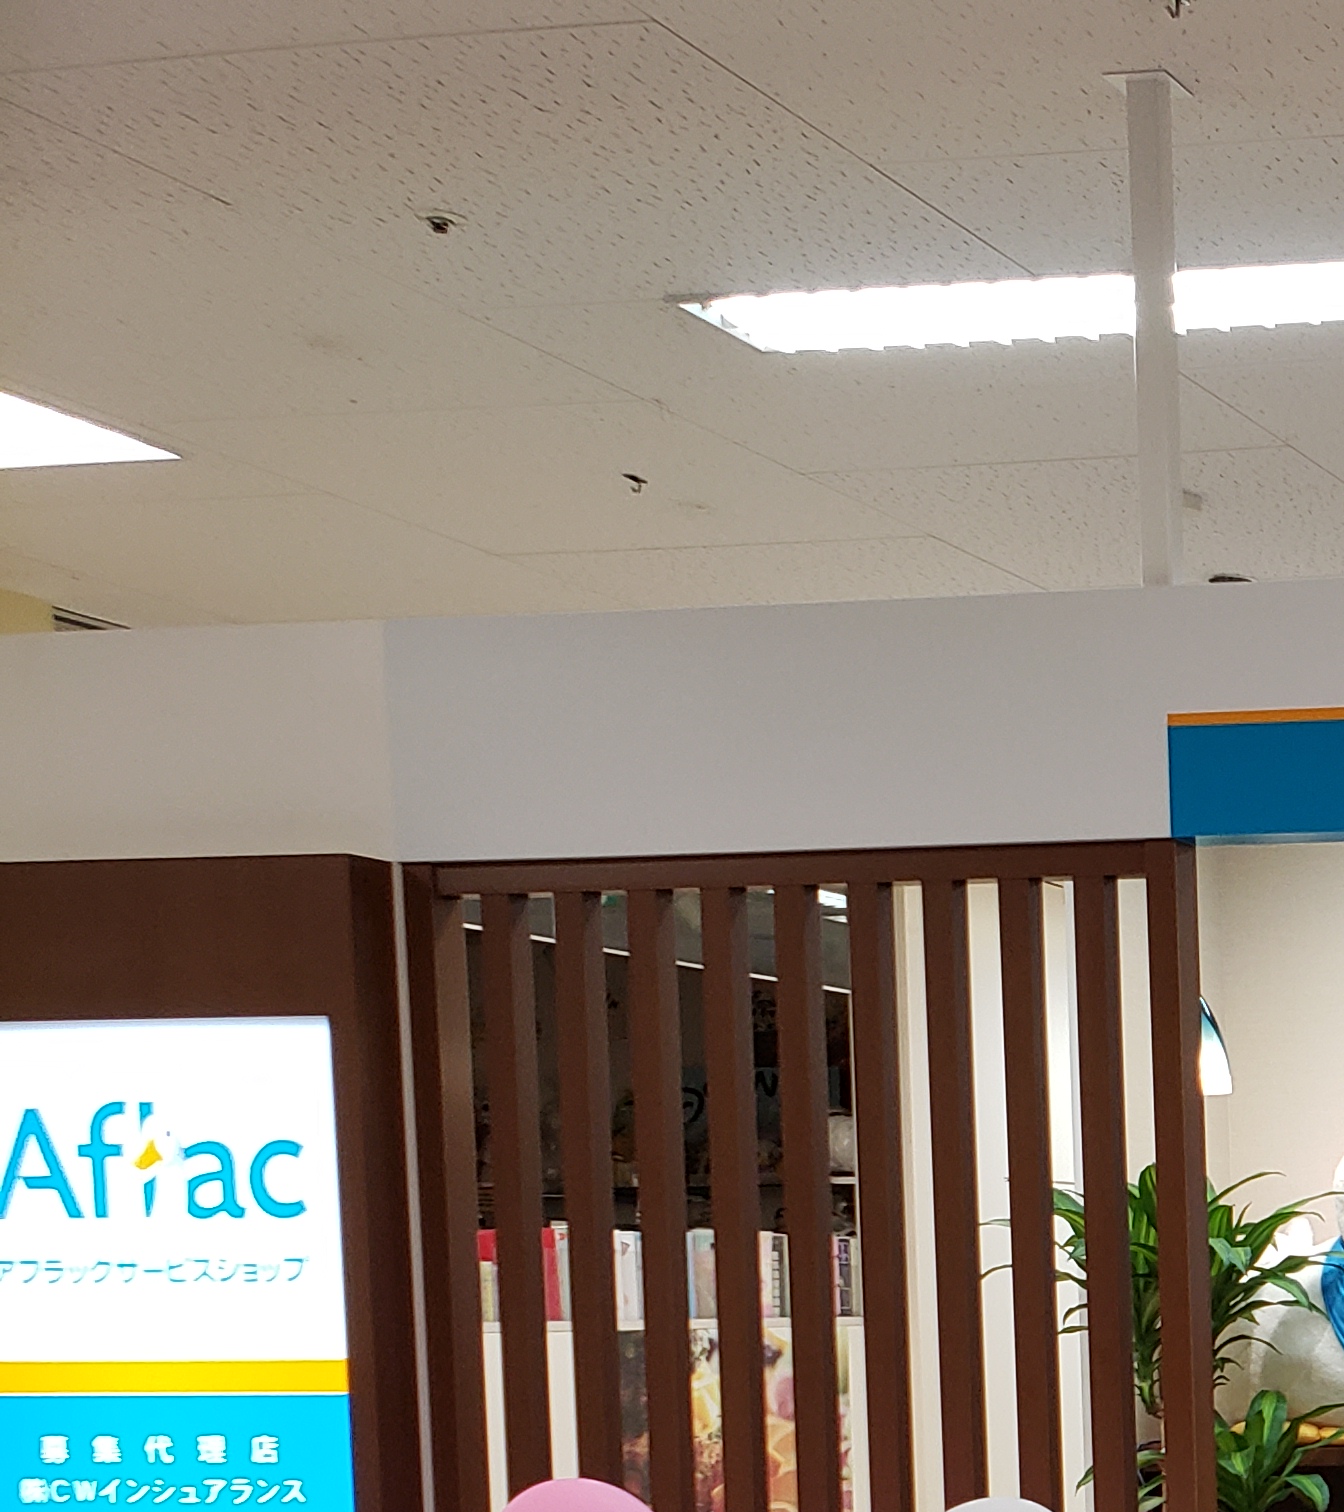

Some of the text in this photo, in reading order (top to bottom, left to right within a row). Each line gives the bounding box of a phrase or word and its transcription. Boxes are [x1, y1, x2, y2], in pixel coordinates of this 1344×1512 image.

[0, 1102, 307, 1219] Aflac
[0, 1257, 308, 1283] アフラックサービスショップ
[39, 1435, 279, 1464] 募集代理店
